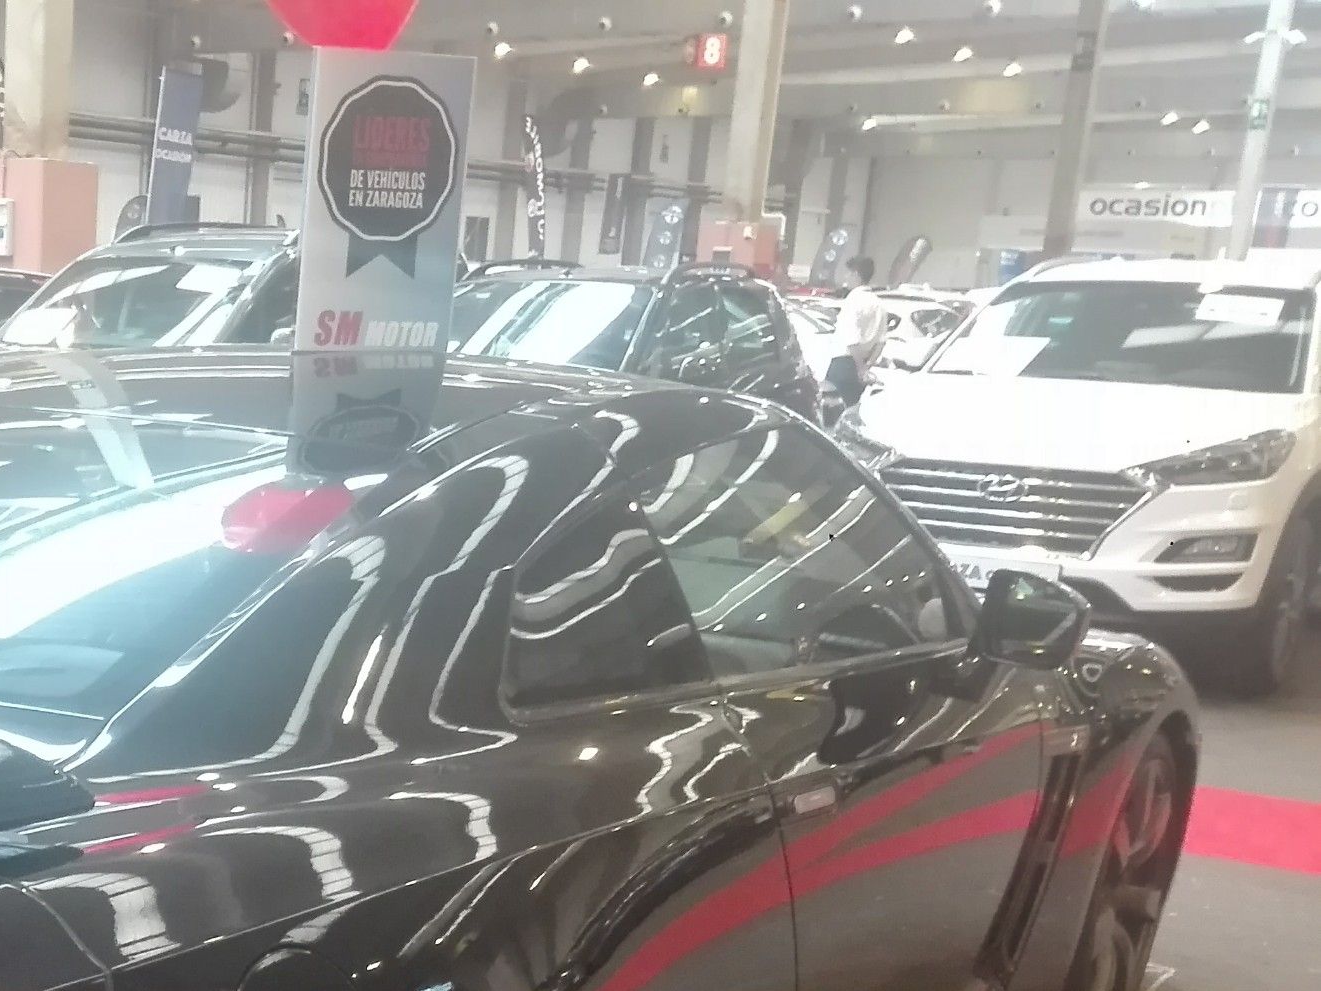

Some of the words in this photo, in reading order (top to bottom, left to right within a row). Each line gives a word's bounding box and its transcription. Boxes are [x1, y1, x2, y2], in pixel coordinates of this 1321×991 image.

[703, 36, 721, 65] 8
[349, 168, 363, 189] DE
[348, 189, 363, 208] EN
[365, 190, 424, 209] ZARAGOZA
[313, 309, 364, 346] SM
[364, 319, 439, 347] MOTOR
